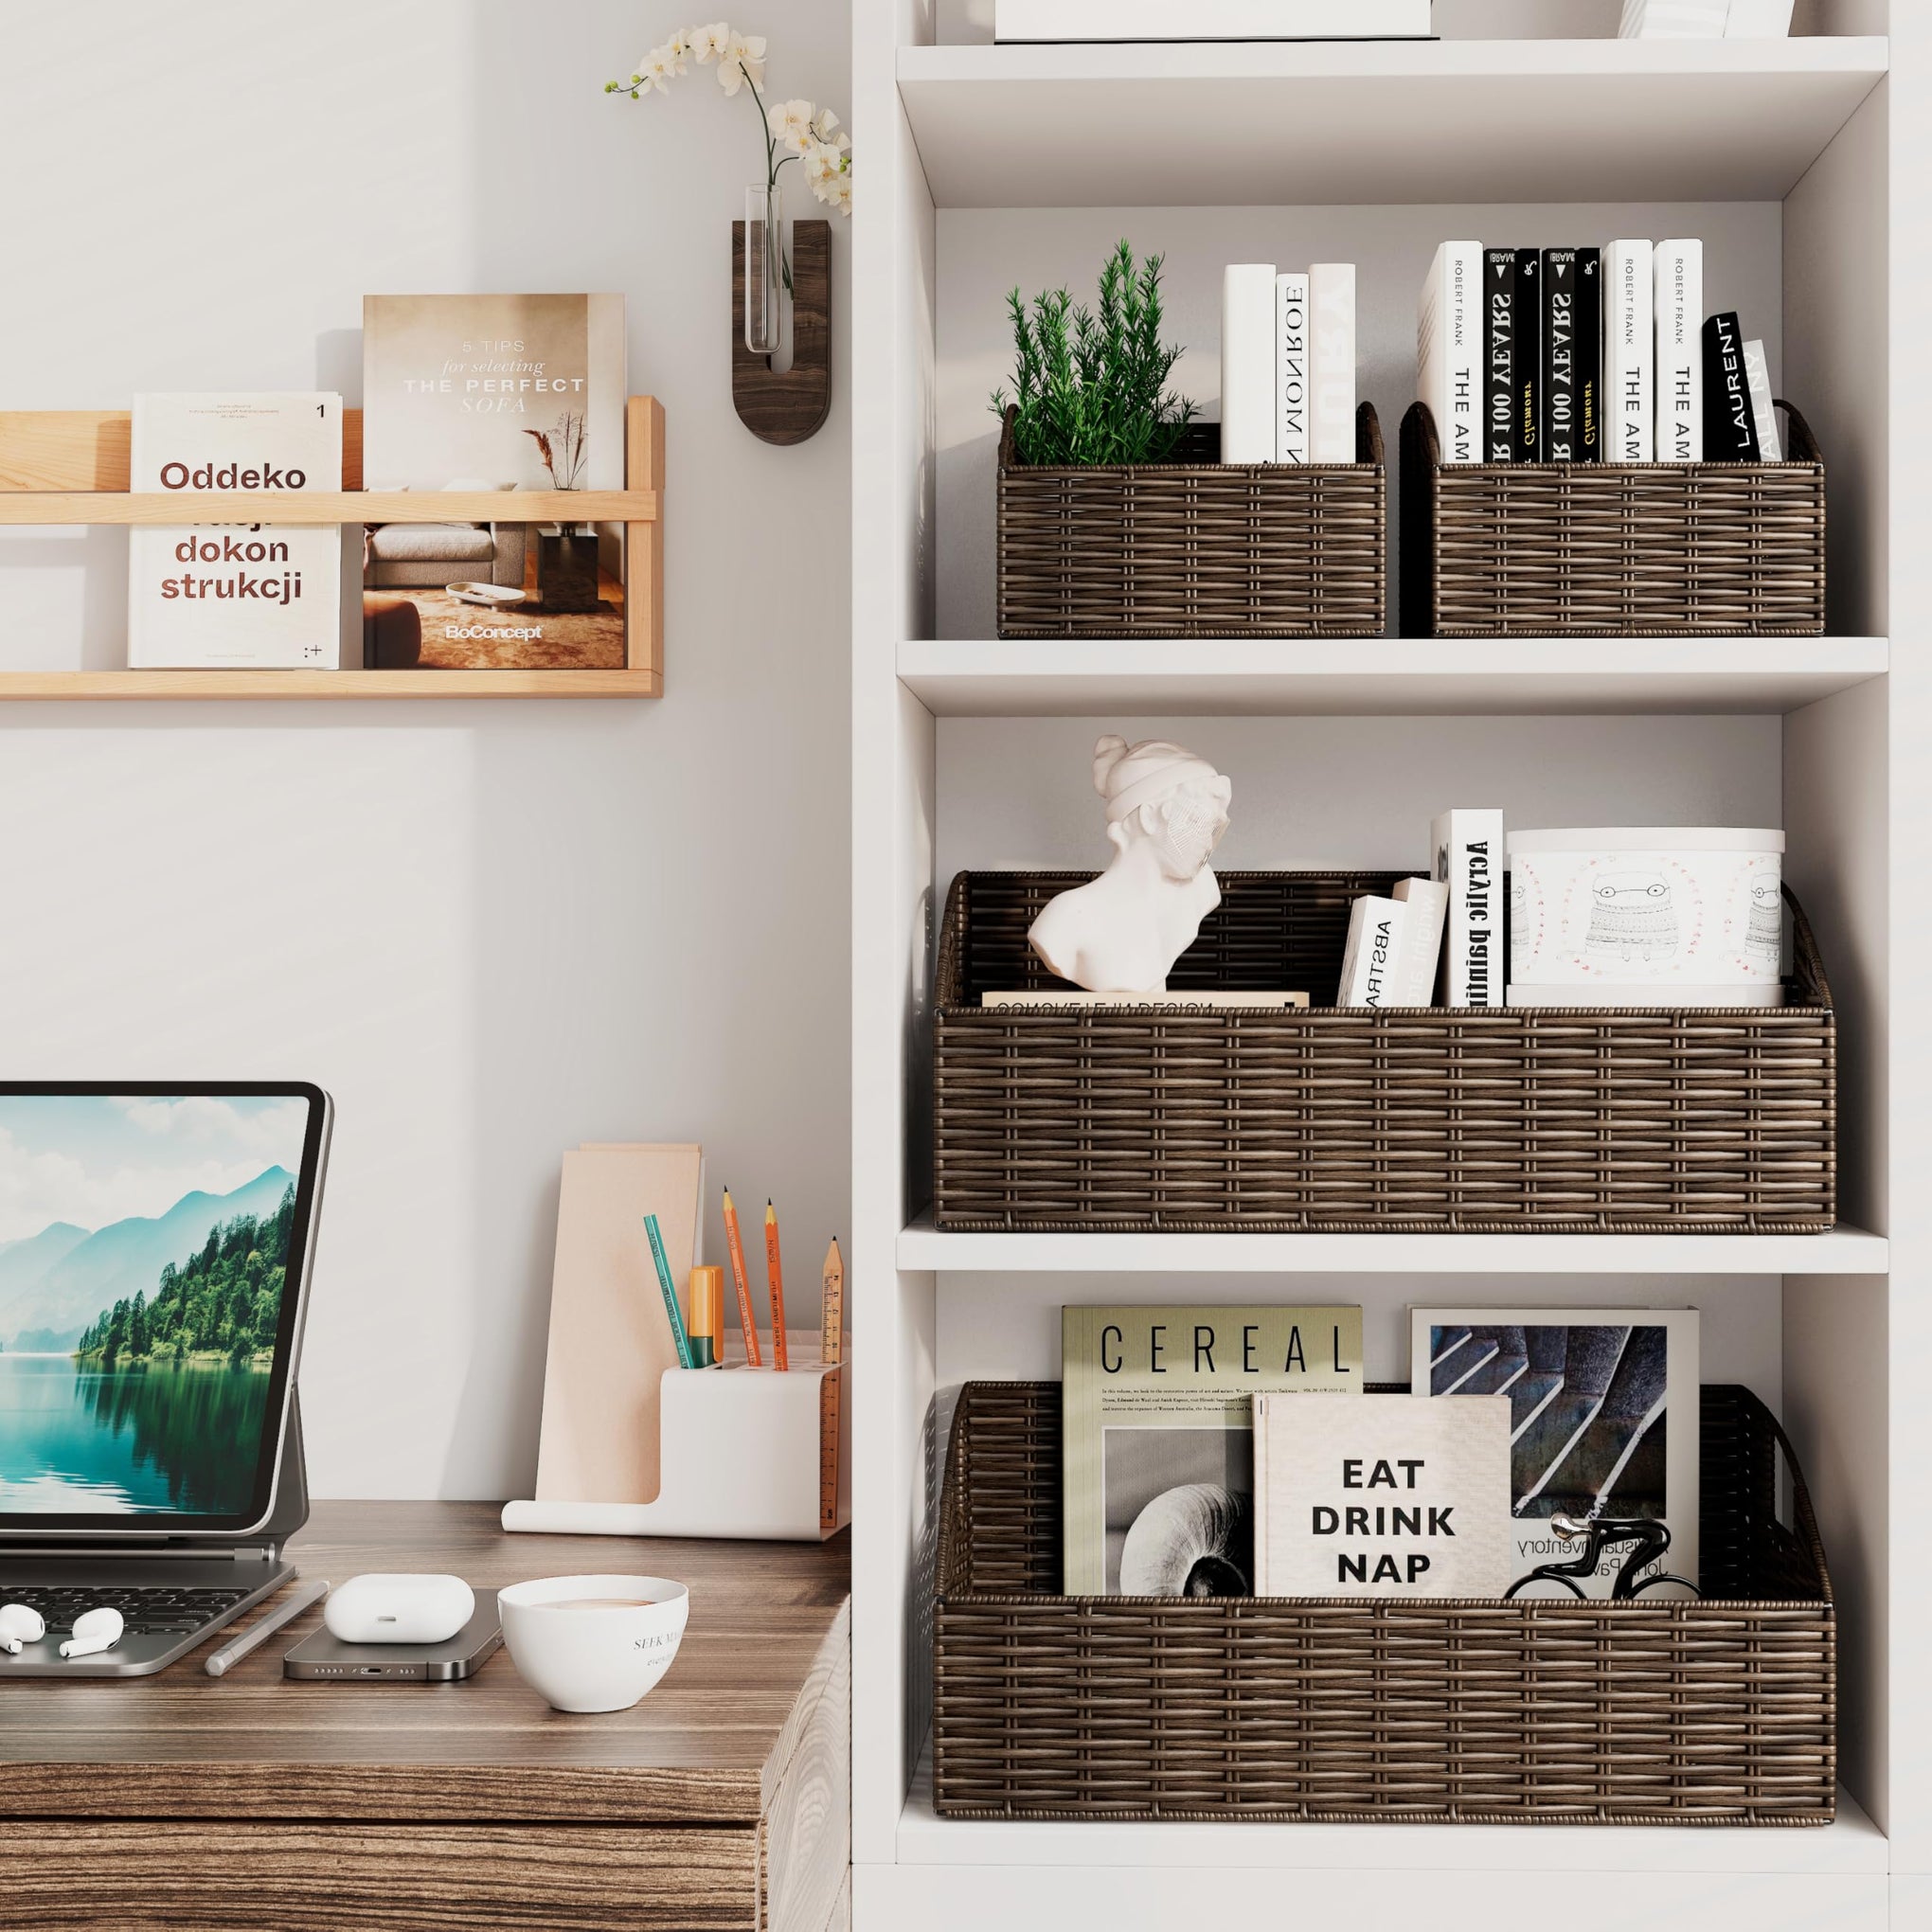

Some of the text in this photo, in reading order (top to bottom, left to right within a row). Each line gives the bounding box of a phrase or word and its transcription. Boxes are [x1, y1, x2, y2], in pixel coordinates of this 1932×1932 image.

[1455, 259, 1463, 347] ROBERT FRANK
[1625, 259, 1634, 345] ROBERT FRANK
[462, 340, 525, 352] 5 TIPS
[442, 356, 546, 377] for selecting
[403, 378, 583, 393] THE PERFECT
[1456, 368, 1469, 412] THE
[1626, 367, 1640, 411] THE
[1675, 367, 1690, 411] THE
[1716, 317, 1750, 448] LAURENT
[316, 404, 324, 418] 1
[460, 397, 527, 413] SOFA
[160, 462, 306, 490] Oddeko
[175, 535, 289, 563] dokon
[161, 572, 301, 605] strukcji
[445, 625, 543, 642] BoConcept
[1101, 1326, 1351, 1373] CEREAL
[1344, 1459, 1424, 1489] EAT
[1313, 1507, 1456, 1536] DRINK
[1338, 1554, 1430, 1583] NAP
